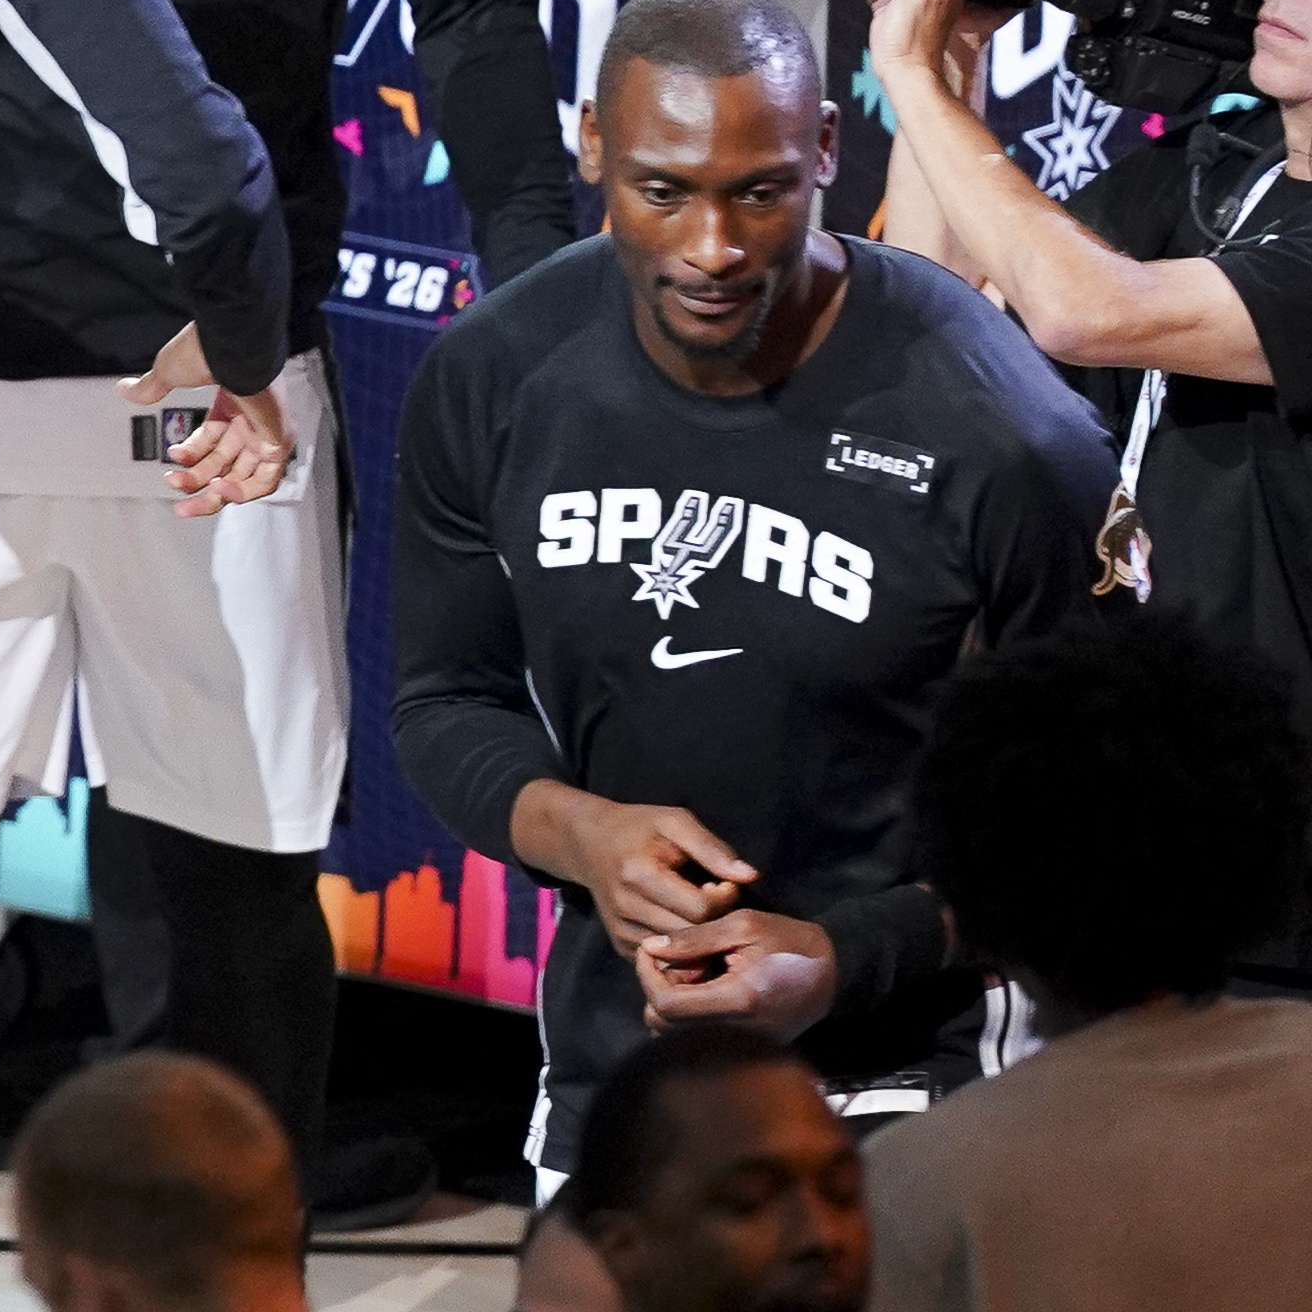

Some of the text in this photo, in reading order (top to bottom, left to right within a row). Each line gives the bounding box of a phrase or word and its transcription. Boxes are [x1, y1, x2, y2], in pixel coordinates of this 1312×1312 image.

[384, 257, 449, 312] '26
[841, 446, 919, 480] LEDGER
[537, 487, 874, 623] SPURS
